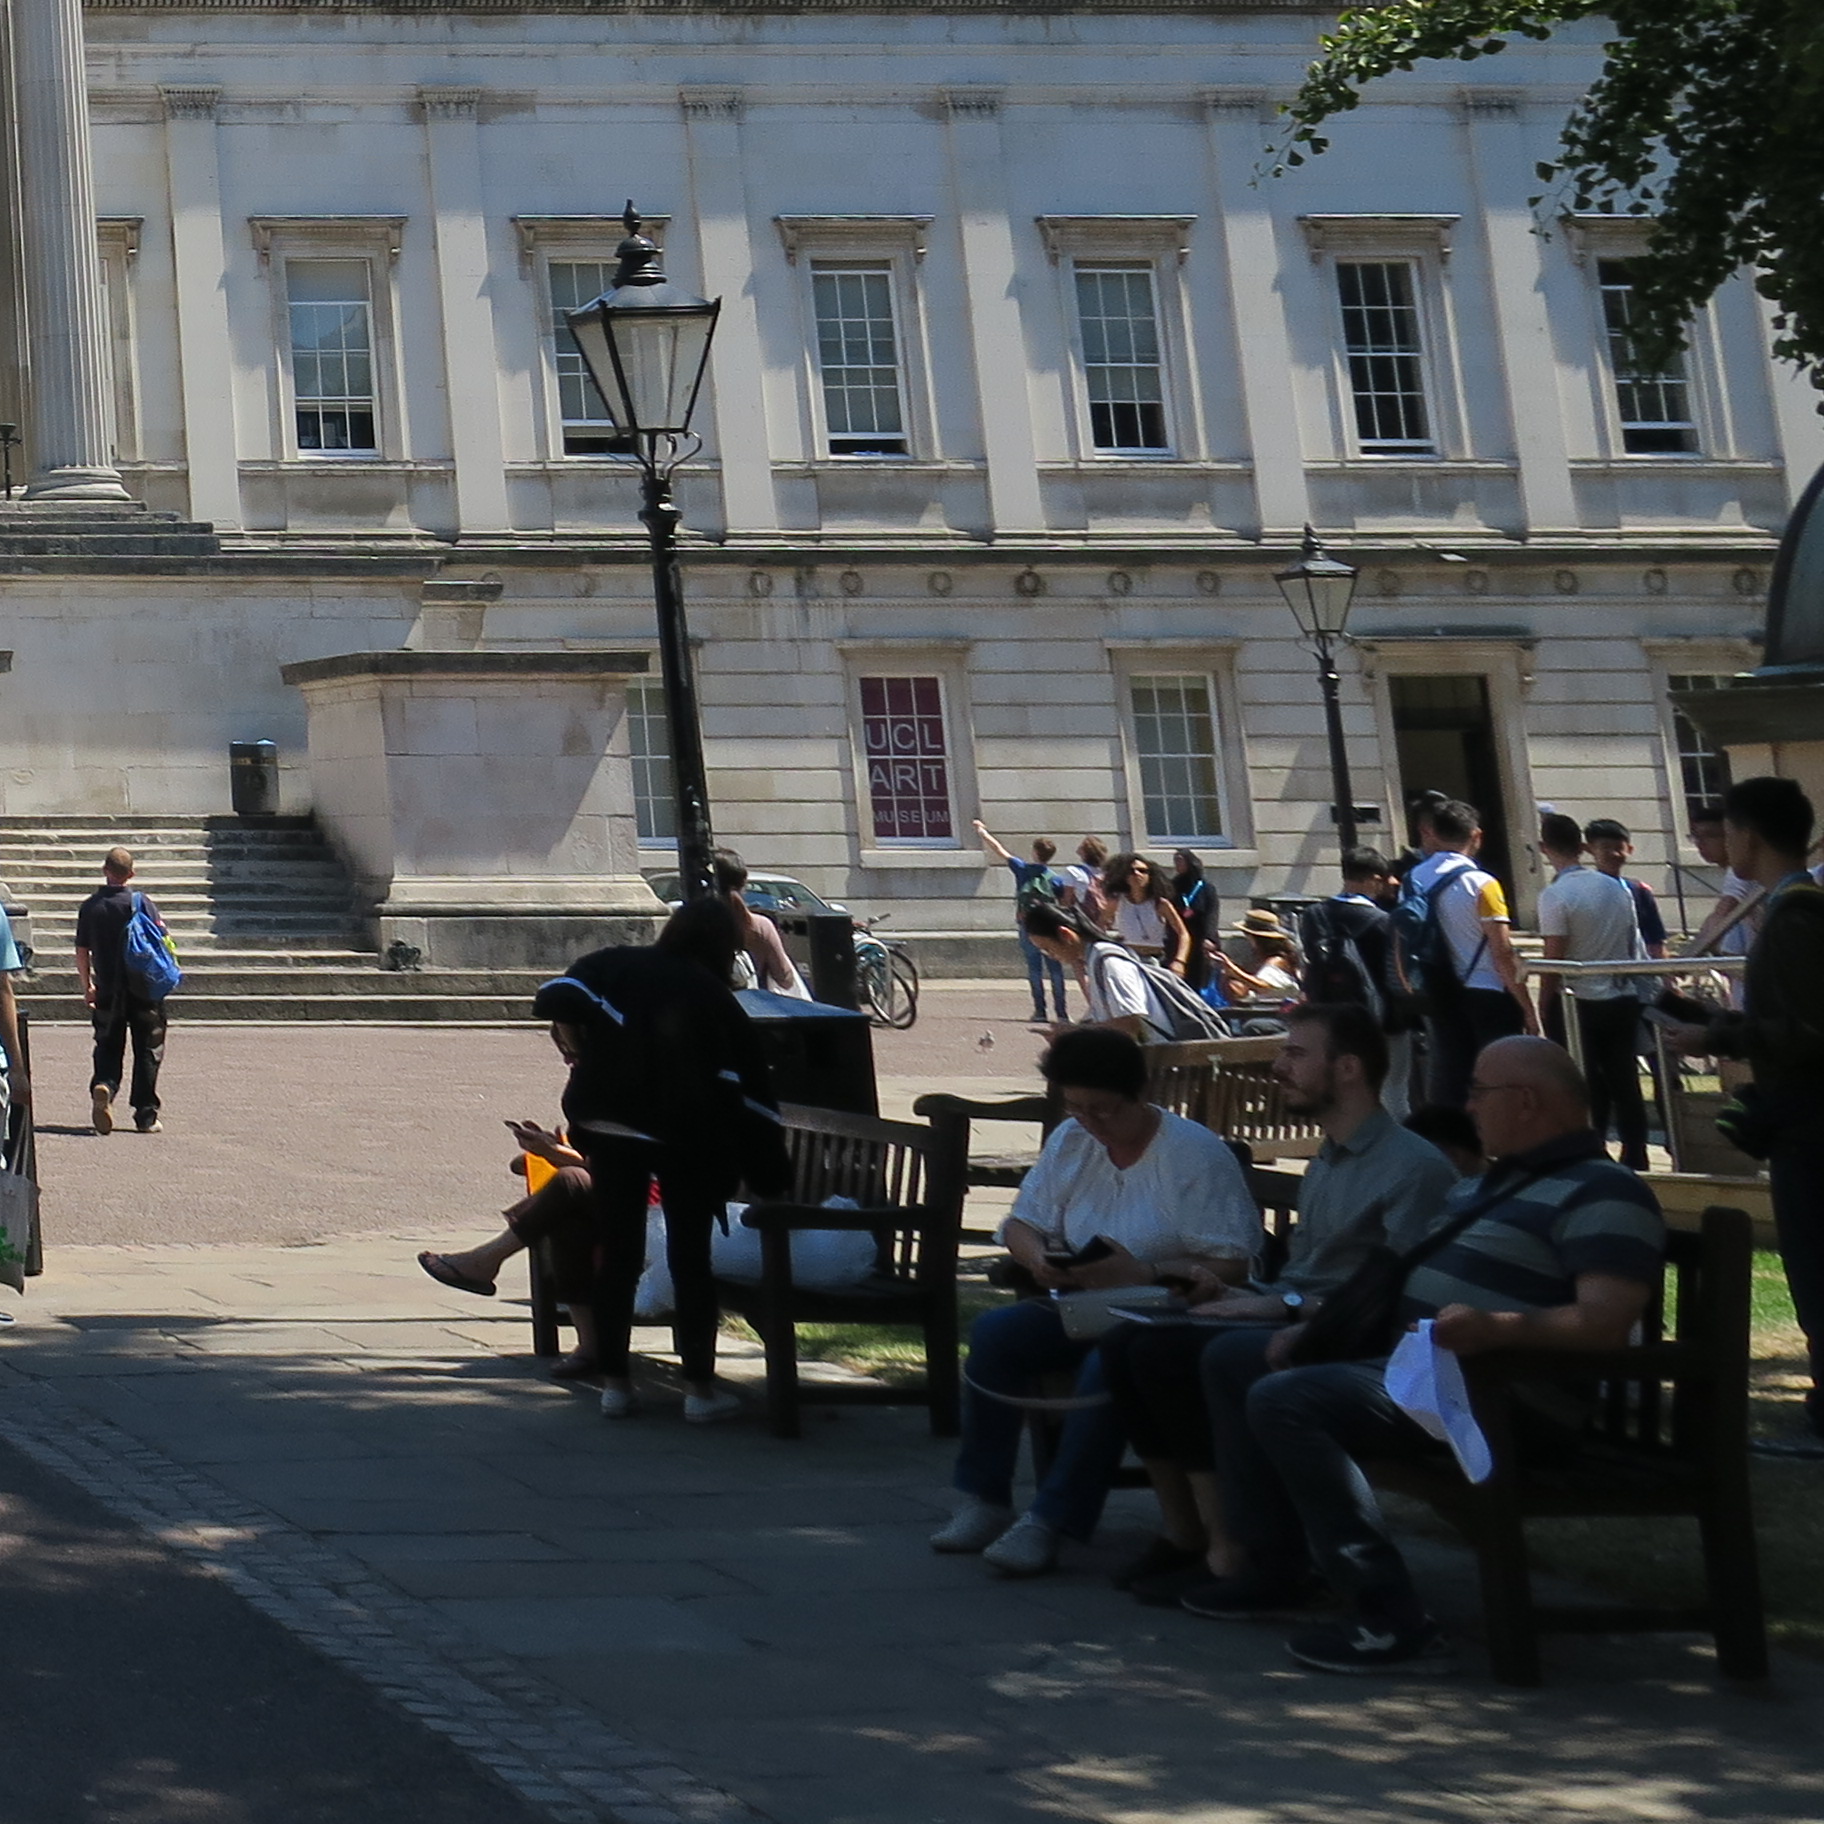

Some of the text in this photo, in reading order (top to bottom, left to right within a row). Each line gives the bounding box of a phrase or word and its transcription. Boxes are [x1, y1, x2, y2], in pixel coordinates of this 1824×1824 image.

[865, 723, 942, 750] UCL
[870, 764, 942, 791] ART
[874, 810, 950, 823] MUSEUM
